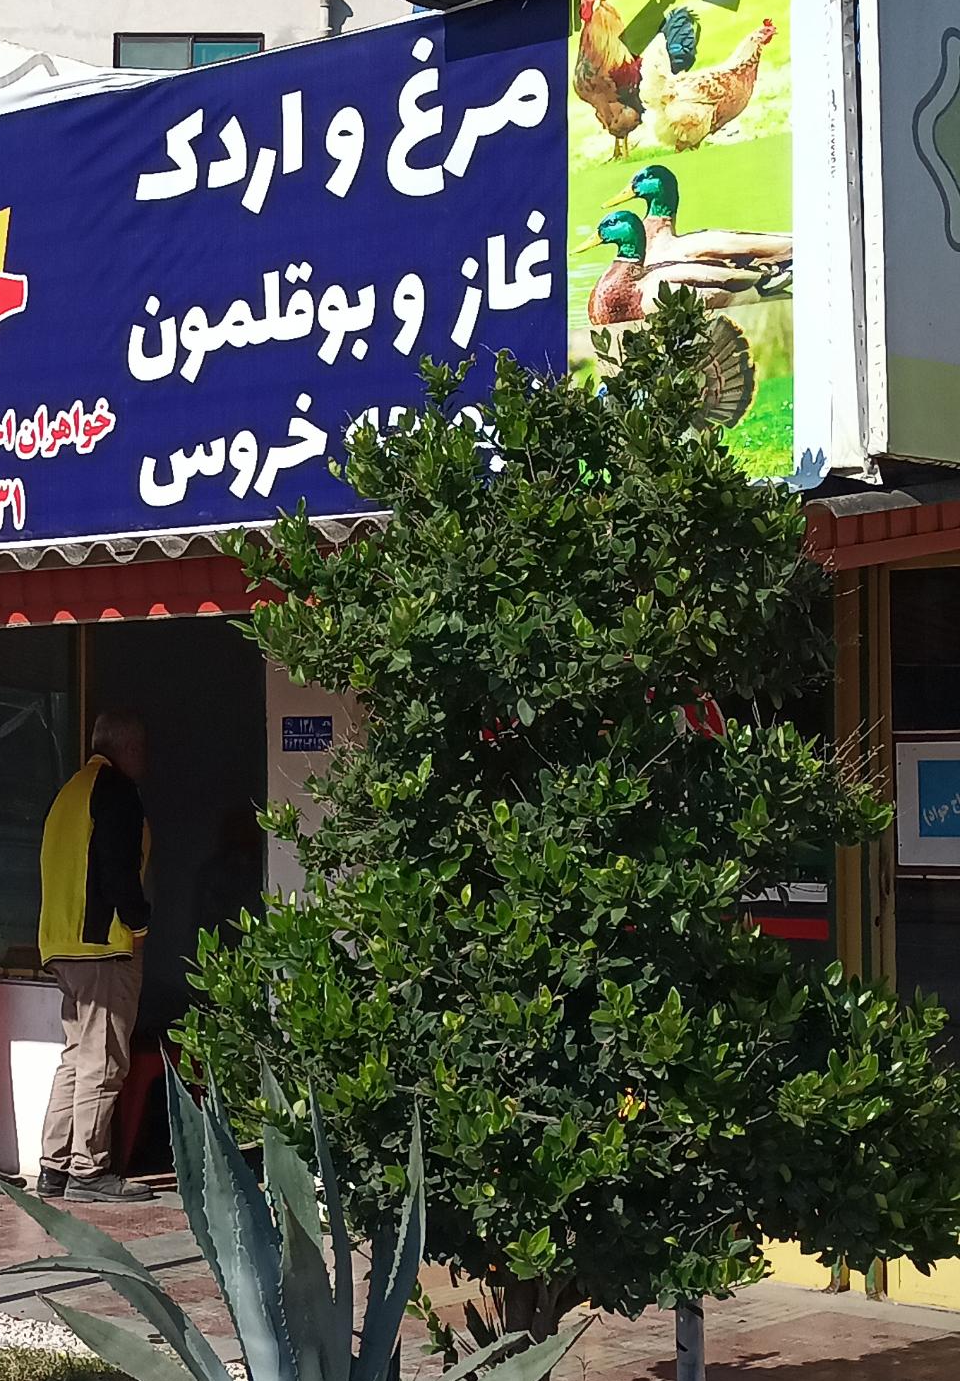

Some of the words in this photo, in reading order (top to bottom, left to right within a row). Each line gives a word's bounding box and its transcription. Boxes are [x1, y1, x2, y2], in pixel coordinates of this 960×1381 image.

[135, 90, 303, 214] اردک
[325, 106, 365, 198] و
[386, 37, 549, 197] مرغ
[127, 261, 376, 384] بوقلمون
[392, 273, 426, 356] و
[450, 210, 552, 350] غاز
[17, 400, 113, 457] خواهران
[139, 392, 328, 507] خروس
